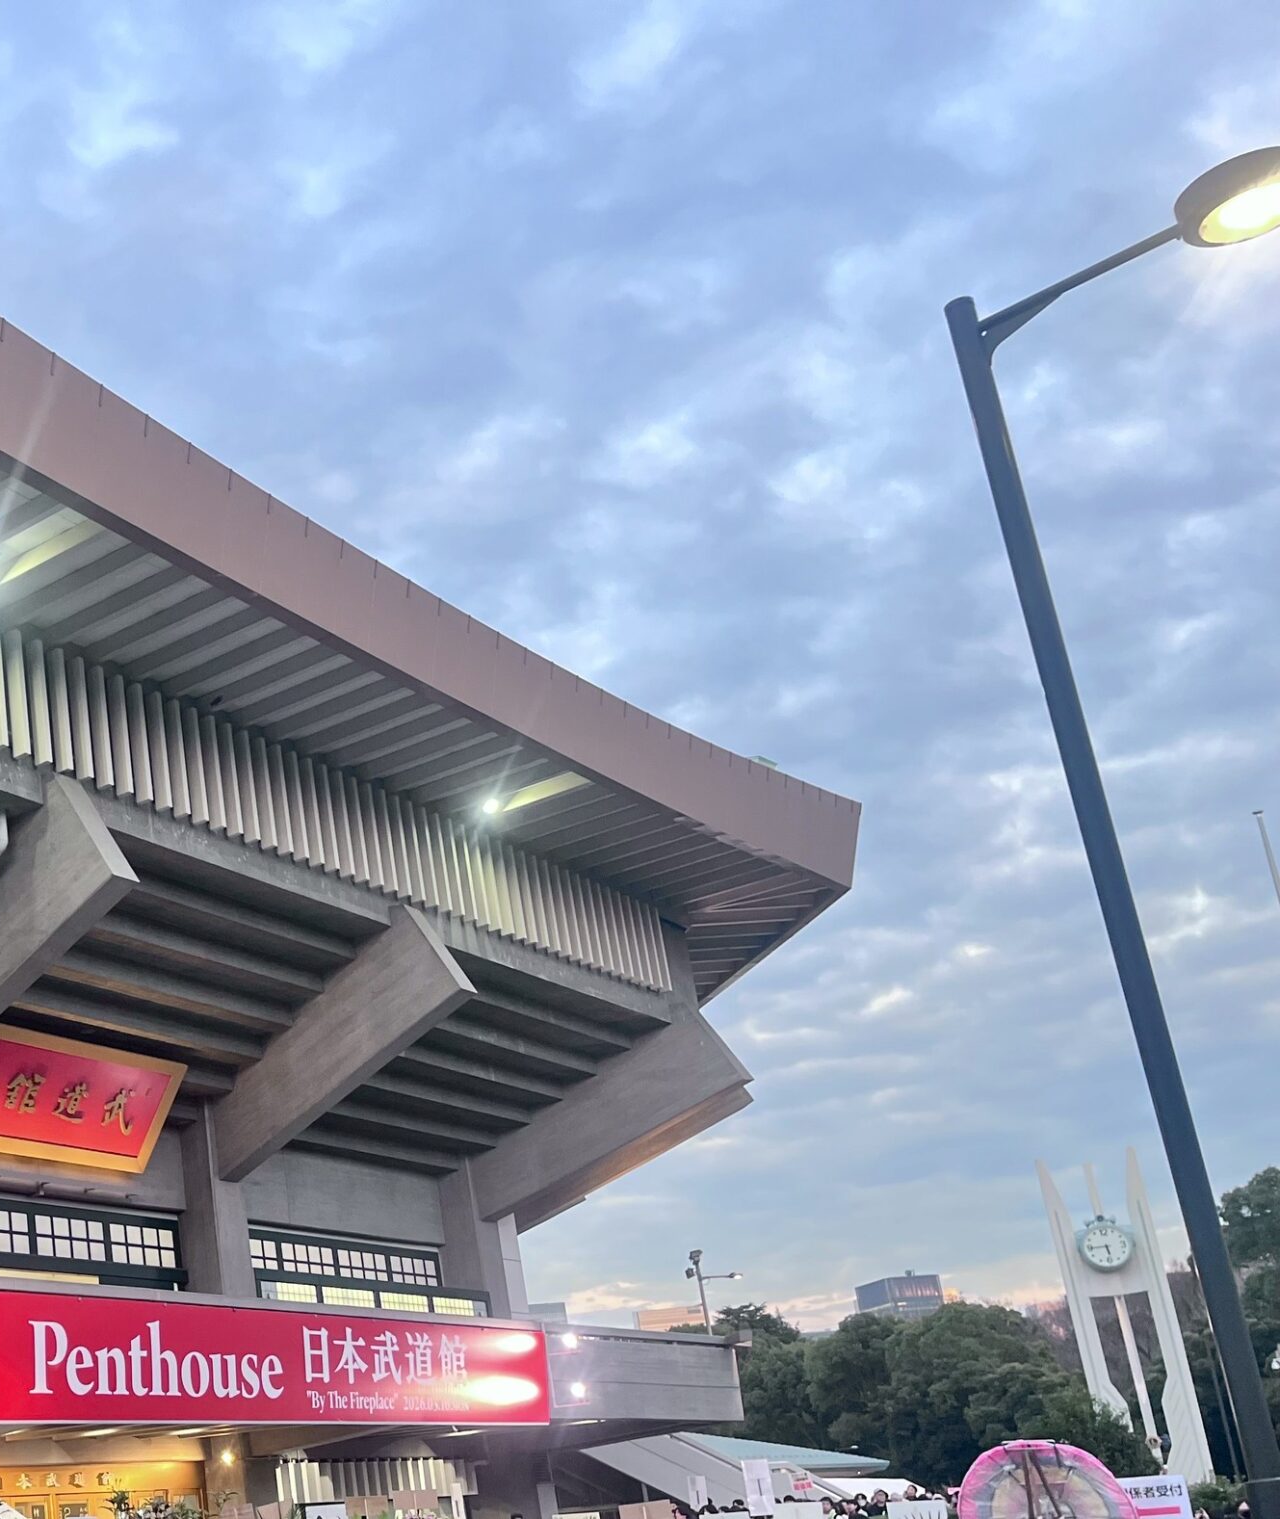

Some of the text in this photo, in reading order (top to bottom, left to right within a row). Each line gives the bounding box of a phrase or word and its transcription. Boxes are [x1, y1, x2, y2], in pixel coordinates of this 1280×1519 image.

[28, 1320, 284, 1399] Penthouse
[303, 1326, 469, 1386] 日本武道館
[307, 1390, 325, 1414] "By
[327, 1391, 348, 1409] The
[350, 1391, 398, 1414] Fireplace"
[1124, 1485, 1183, 1499] 係者受付
